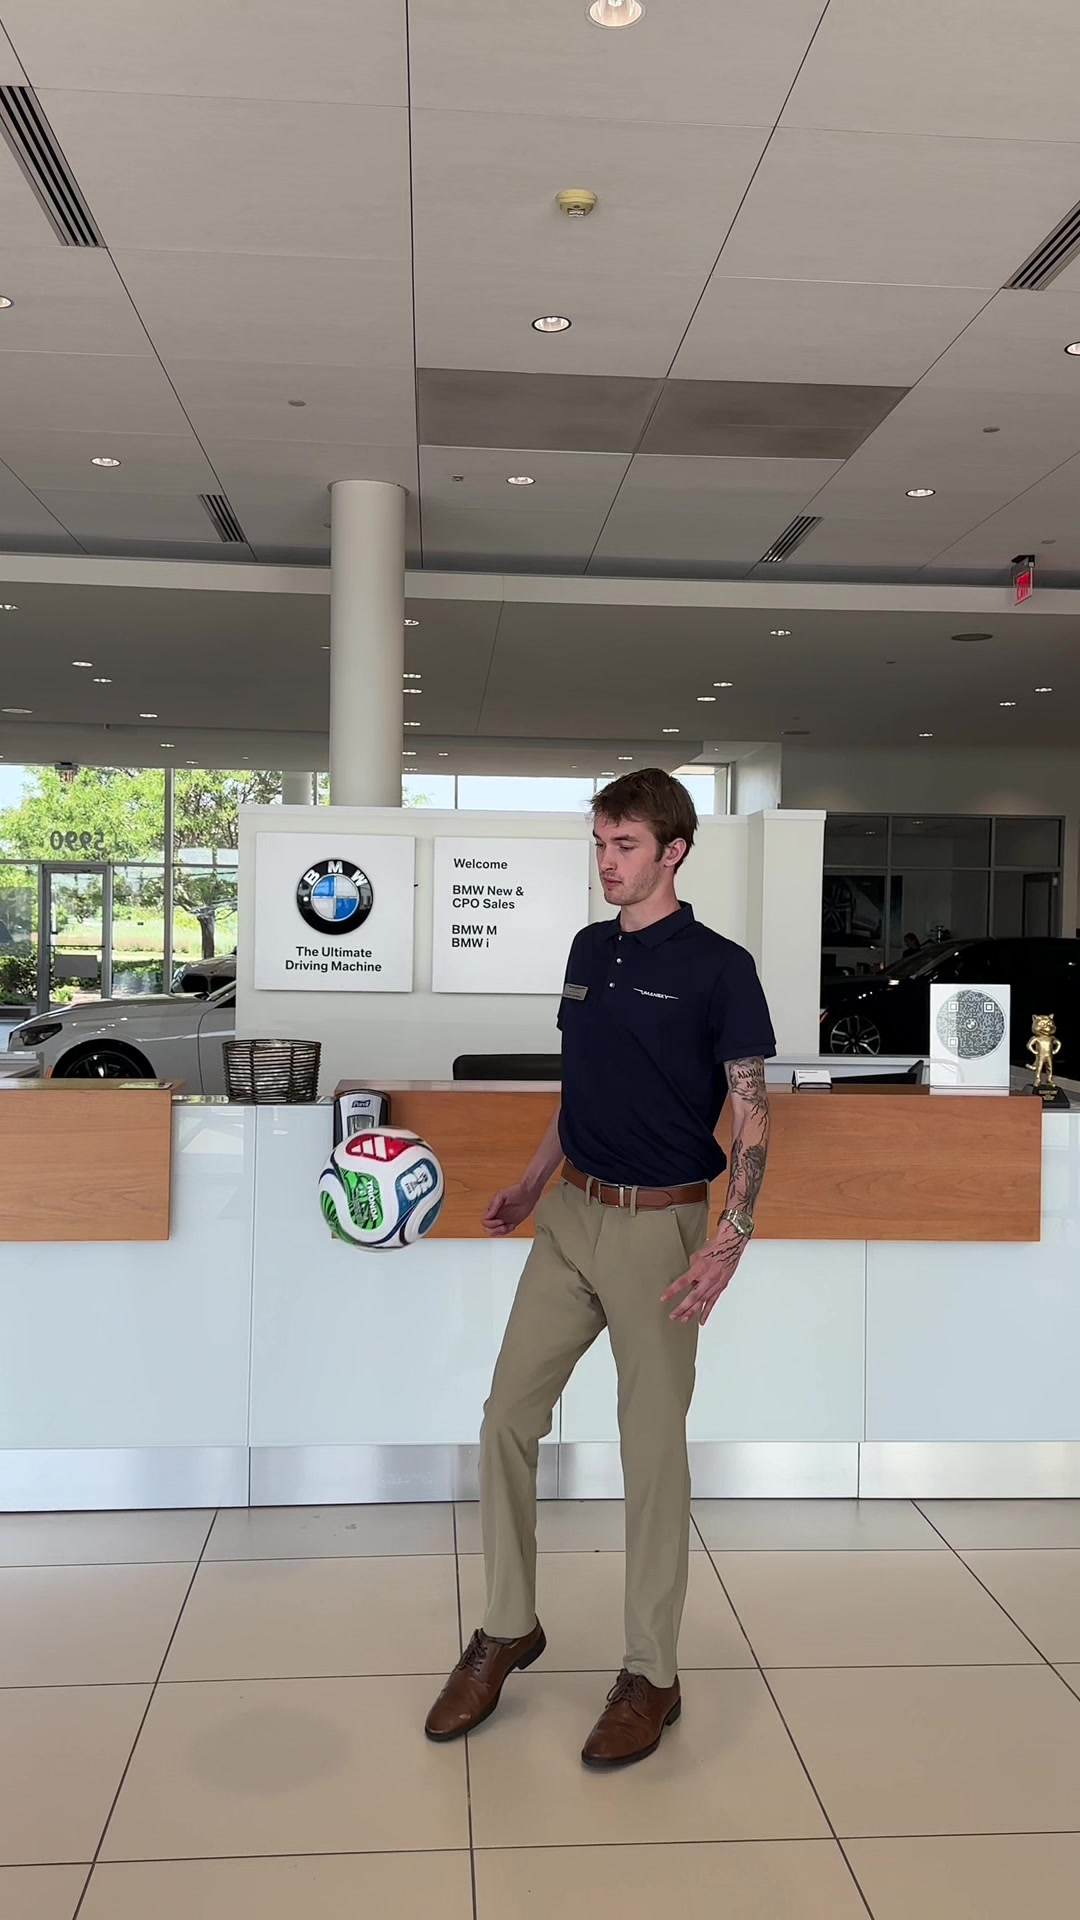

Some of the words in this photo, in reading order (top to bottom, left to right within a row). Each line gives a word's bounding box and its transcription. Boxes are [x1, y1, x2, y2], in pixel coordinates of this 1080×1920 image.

[453, 858, 508, 869] Welcome
[303, 861, 368, 887] BMW
[452, 885, 485, 895] BMW
[487, 886, 513, 896] New
[515, 886, 524, 896] &
[452, 898, 480, 908] CPO
[483, 898, 515, 909] Sales
[452, 924, 484, 934] BMW
[486, 925, 497, 935] M
[451, 937, 484, 948] BMW
[485, 938, 490, 948] i
[295, 946, 319, 957] The
[321, 947, 372, 958] Ultimate
[285, 960, 329, 973] Driving
[331, 961, 382, 972] Machine
[366, 1180, 379, 1221] TRIONDA
